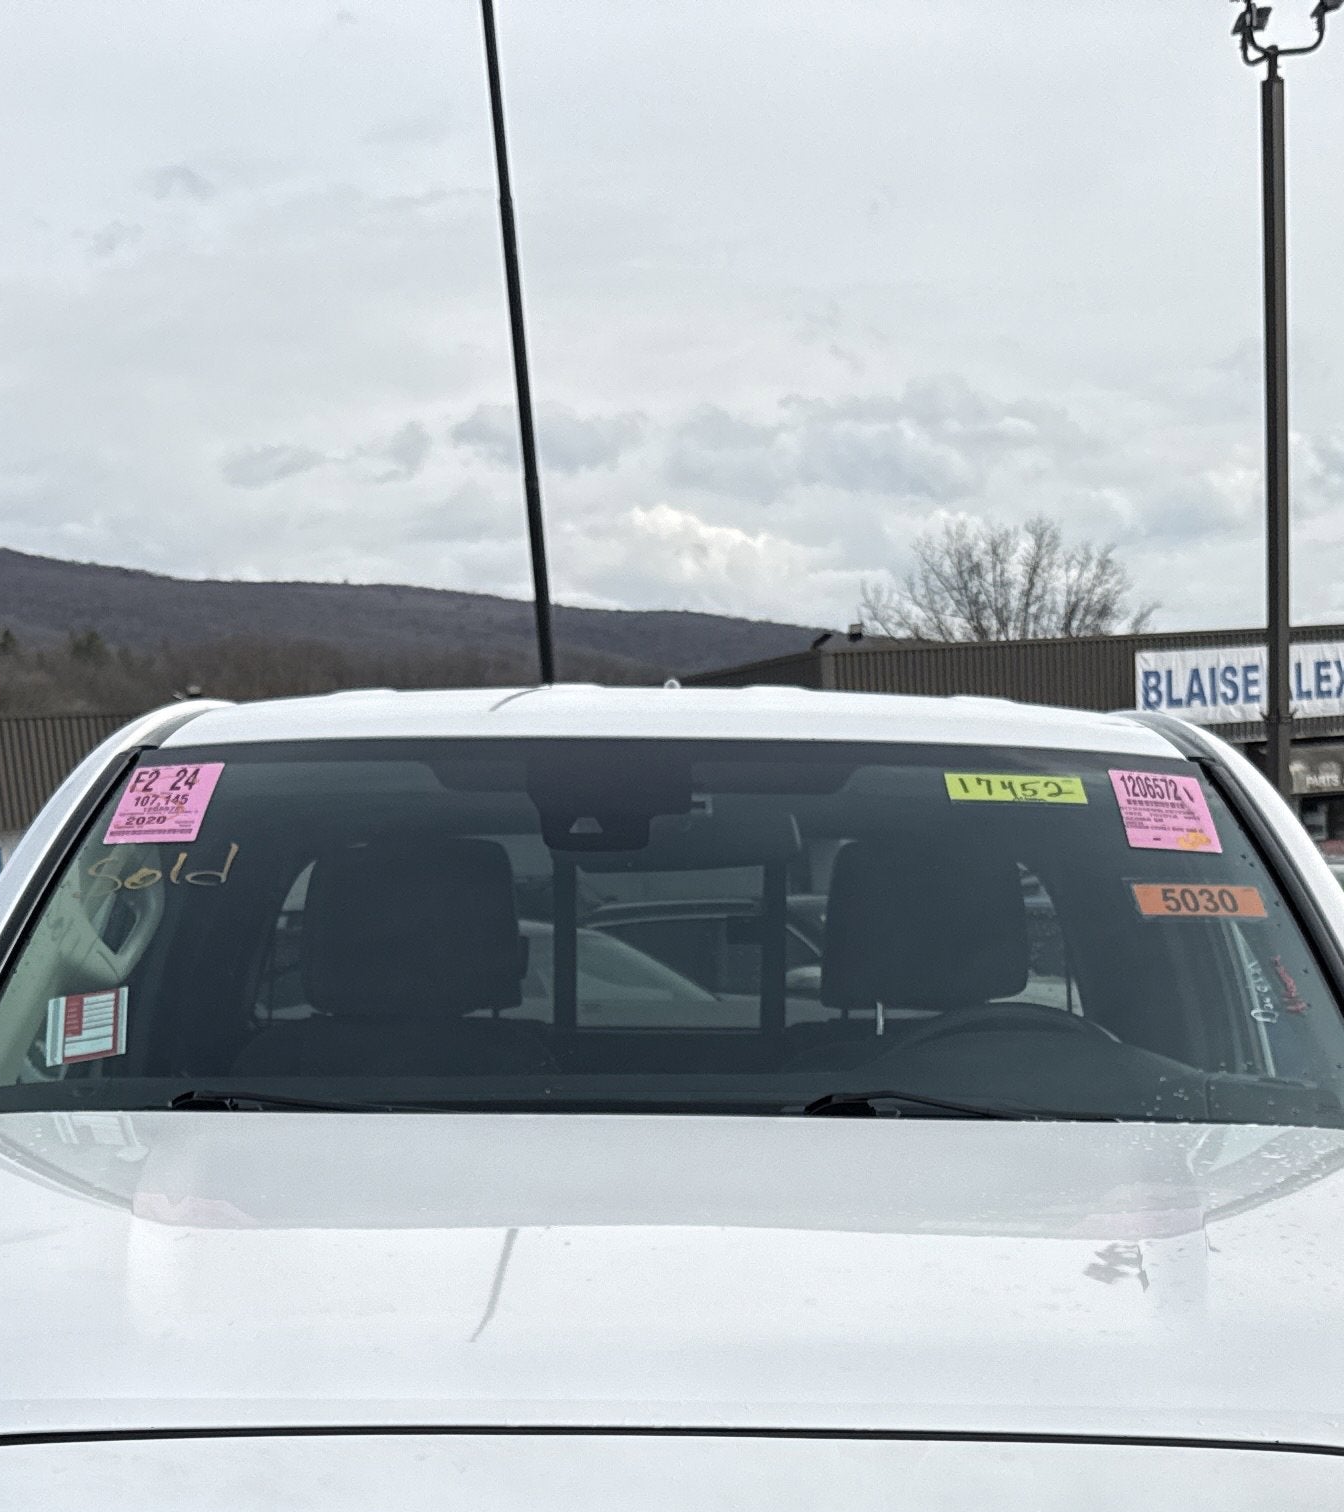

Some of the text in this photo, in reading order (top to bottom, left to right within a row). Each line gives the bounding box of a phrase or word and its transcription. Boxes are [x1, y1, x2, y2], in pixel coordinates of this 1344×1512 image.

[1142, 665, 1262, 709] BLAISE
[129, 768, 200, 793] F2 24
[1120, 775, 1182, 801] 1206572
[1306, 774, 1340, 787] PARTS
[134, 793, 190, 808] 107,145
[125, 815, 167, 826] 2020
[1161, 887, 1239, 914] 5030
